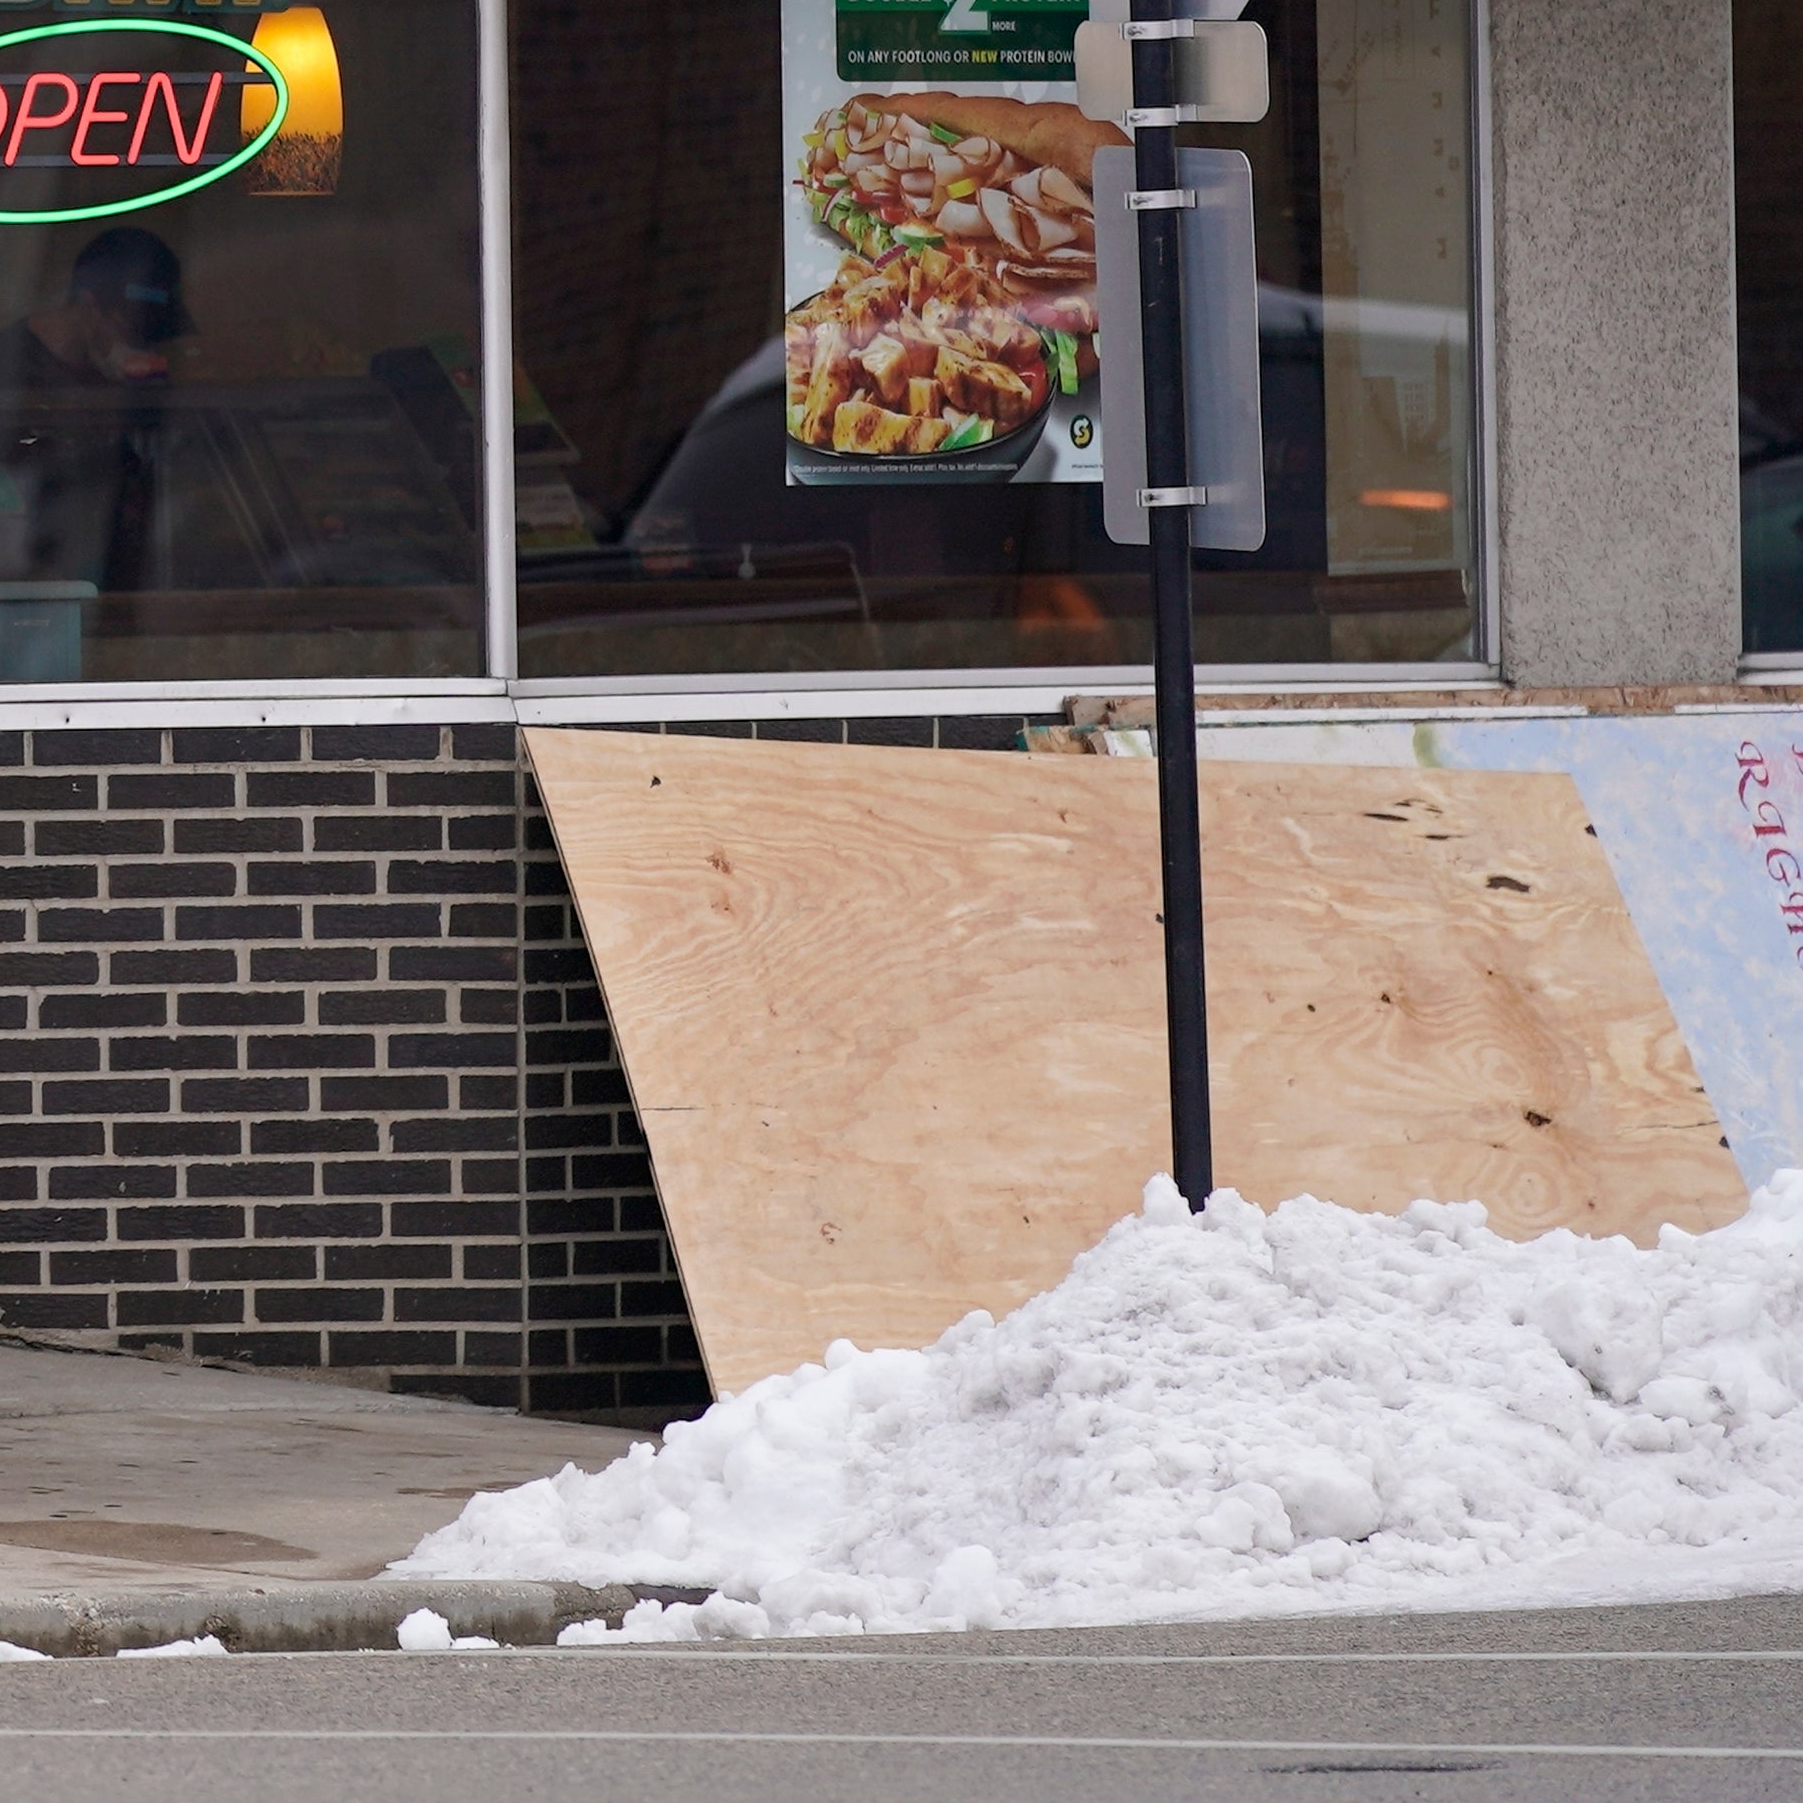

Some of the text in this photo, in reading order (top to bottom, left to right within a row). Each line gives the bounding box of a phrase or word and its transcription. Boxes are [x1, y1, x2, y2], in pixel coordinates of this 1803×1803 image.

[992, 21, 1016, 31] MORE
[848, 50, 1075, 64] ON ANY FOOTLONG OR NEW PROTEIN BOW
[1735, 741, 1803, 970] RIGH
